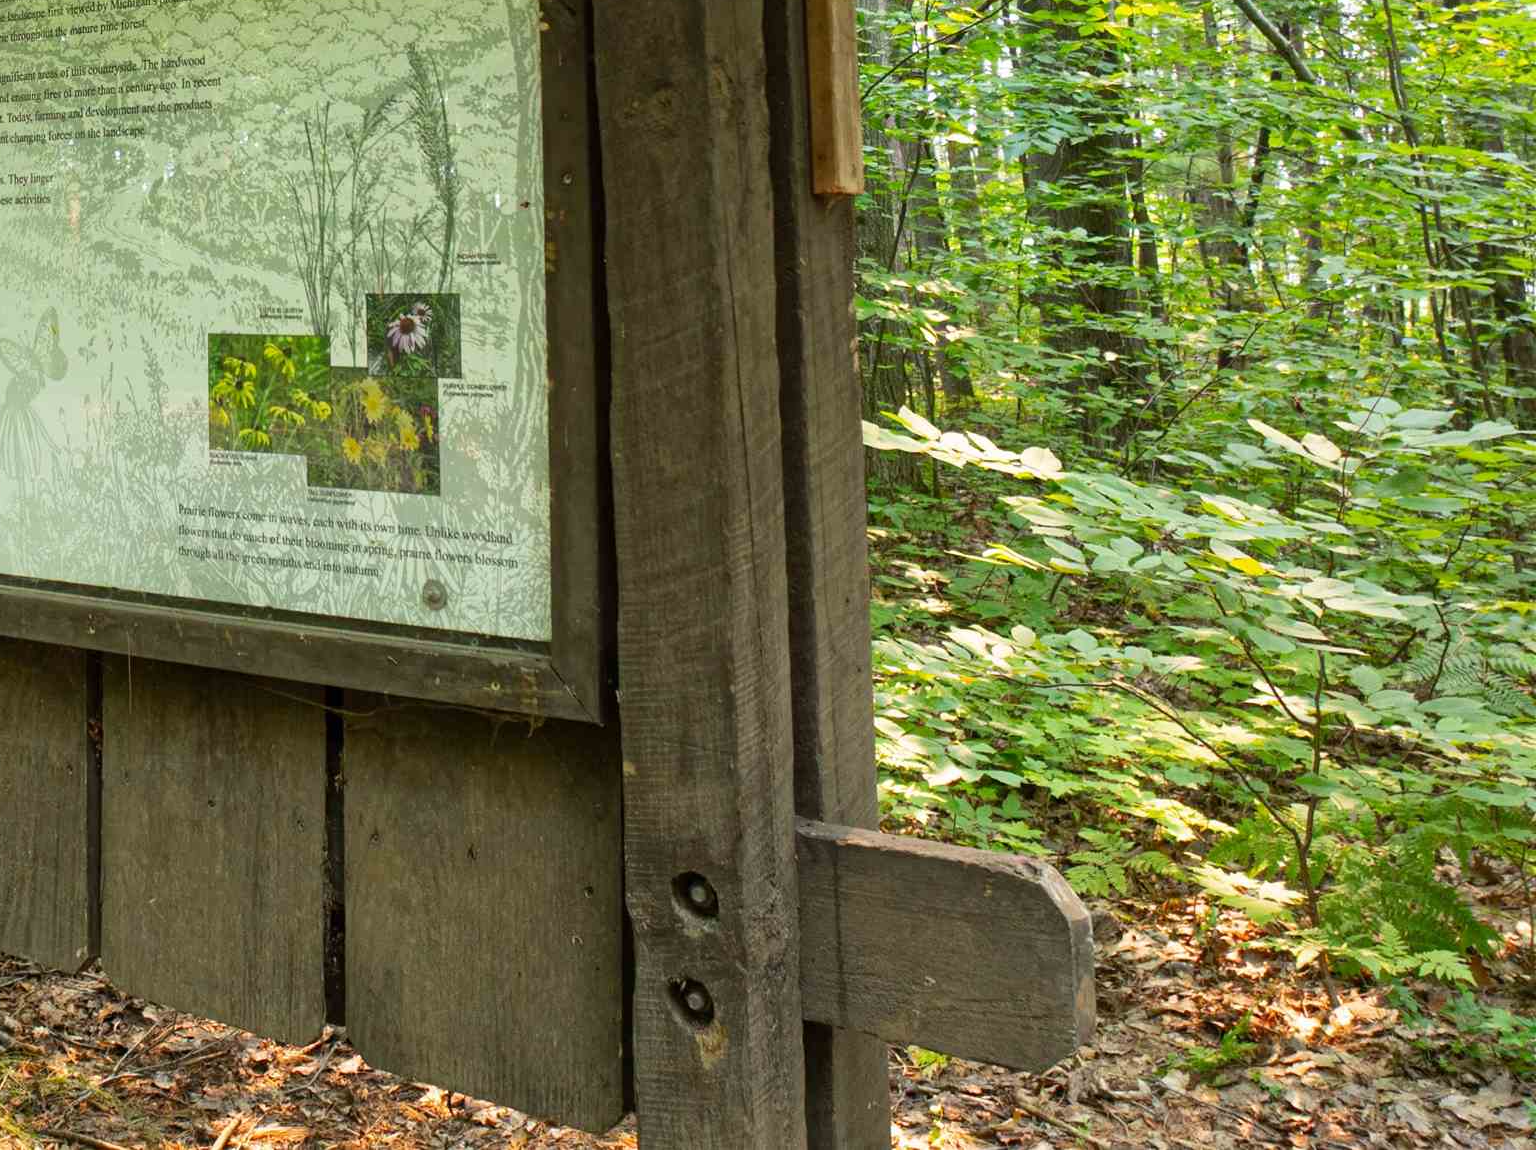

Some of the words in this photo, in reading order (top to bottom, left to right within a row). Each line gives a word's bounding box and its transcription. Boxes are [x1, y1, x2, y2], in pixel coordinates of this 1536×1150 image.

[97, 0, 107, 13] by
[70, 25, 98, 35] mature
[100, 22, 118, 35] pine
[61, 66, 70, 77] of
[142, 59, 158, 70] The
[161, 54, 205, 68] hardwood
[74, 88, 96, 97] more
[97, 85, 115, 95] than
[126, 83, 158, 94] century
[181, 78, 191, 89] In
[194, 77, 221, 88] recent
[6, 112, 32, 124] Today,
[67, 107, 82, 118] and
[84, 105, 138, 118] development
[142, 105, 155, 113] are
[158, 101, 170, 112] the
[174, 99, 212, 114] products
[75, 131, 86, 139] on
[88, 128, 100, 138] the
[8, 174, 28, 186] They
[30, 173, 54, 185] linger
[14, 194, 50, 204] activities
[178, 504, 206, 516] Prairie
[208, 506, 240, 519] flowers
[242, 512, 265, 522] come
[279, 515, 310, 527] waves,
[312, 517, 334, 528] each
[336, 519, 356, 530] with
[360, 521, 372, 531] its
[374, 524, 394, 533] own
[425, 526, 460, 539] Unlike
[462, 531, 512, 544] woodland
[178, 524, 208, 537] flowers
[212, 528, 226, 539] that
[230, 529, 241, 540] do
[270, 534, 280, 544] of
[282, 535, 302, 547] their
[305, 537, 348, 554] blooming
[399, 548, 432, 560] prairie
[434, 549, 472, 563] flowers
[474, 553, 518, 568] blossom
[213, 549, 223, 559] all
[226, 550, 239, 561] the
[304, 559, 320, 569] and
[323, 560, 340, 571] into
